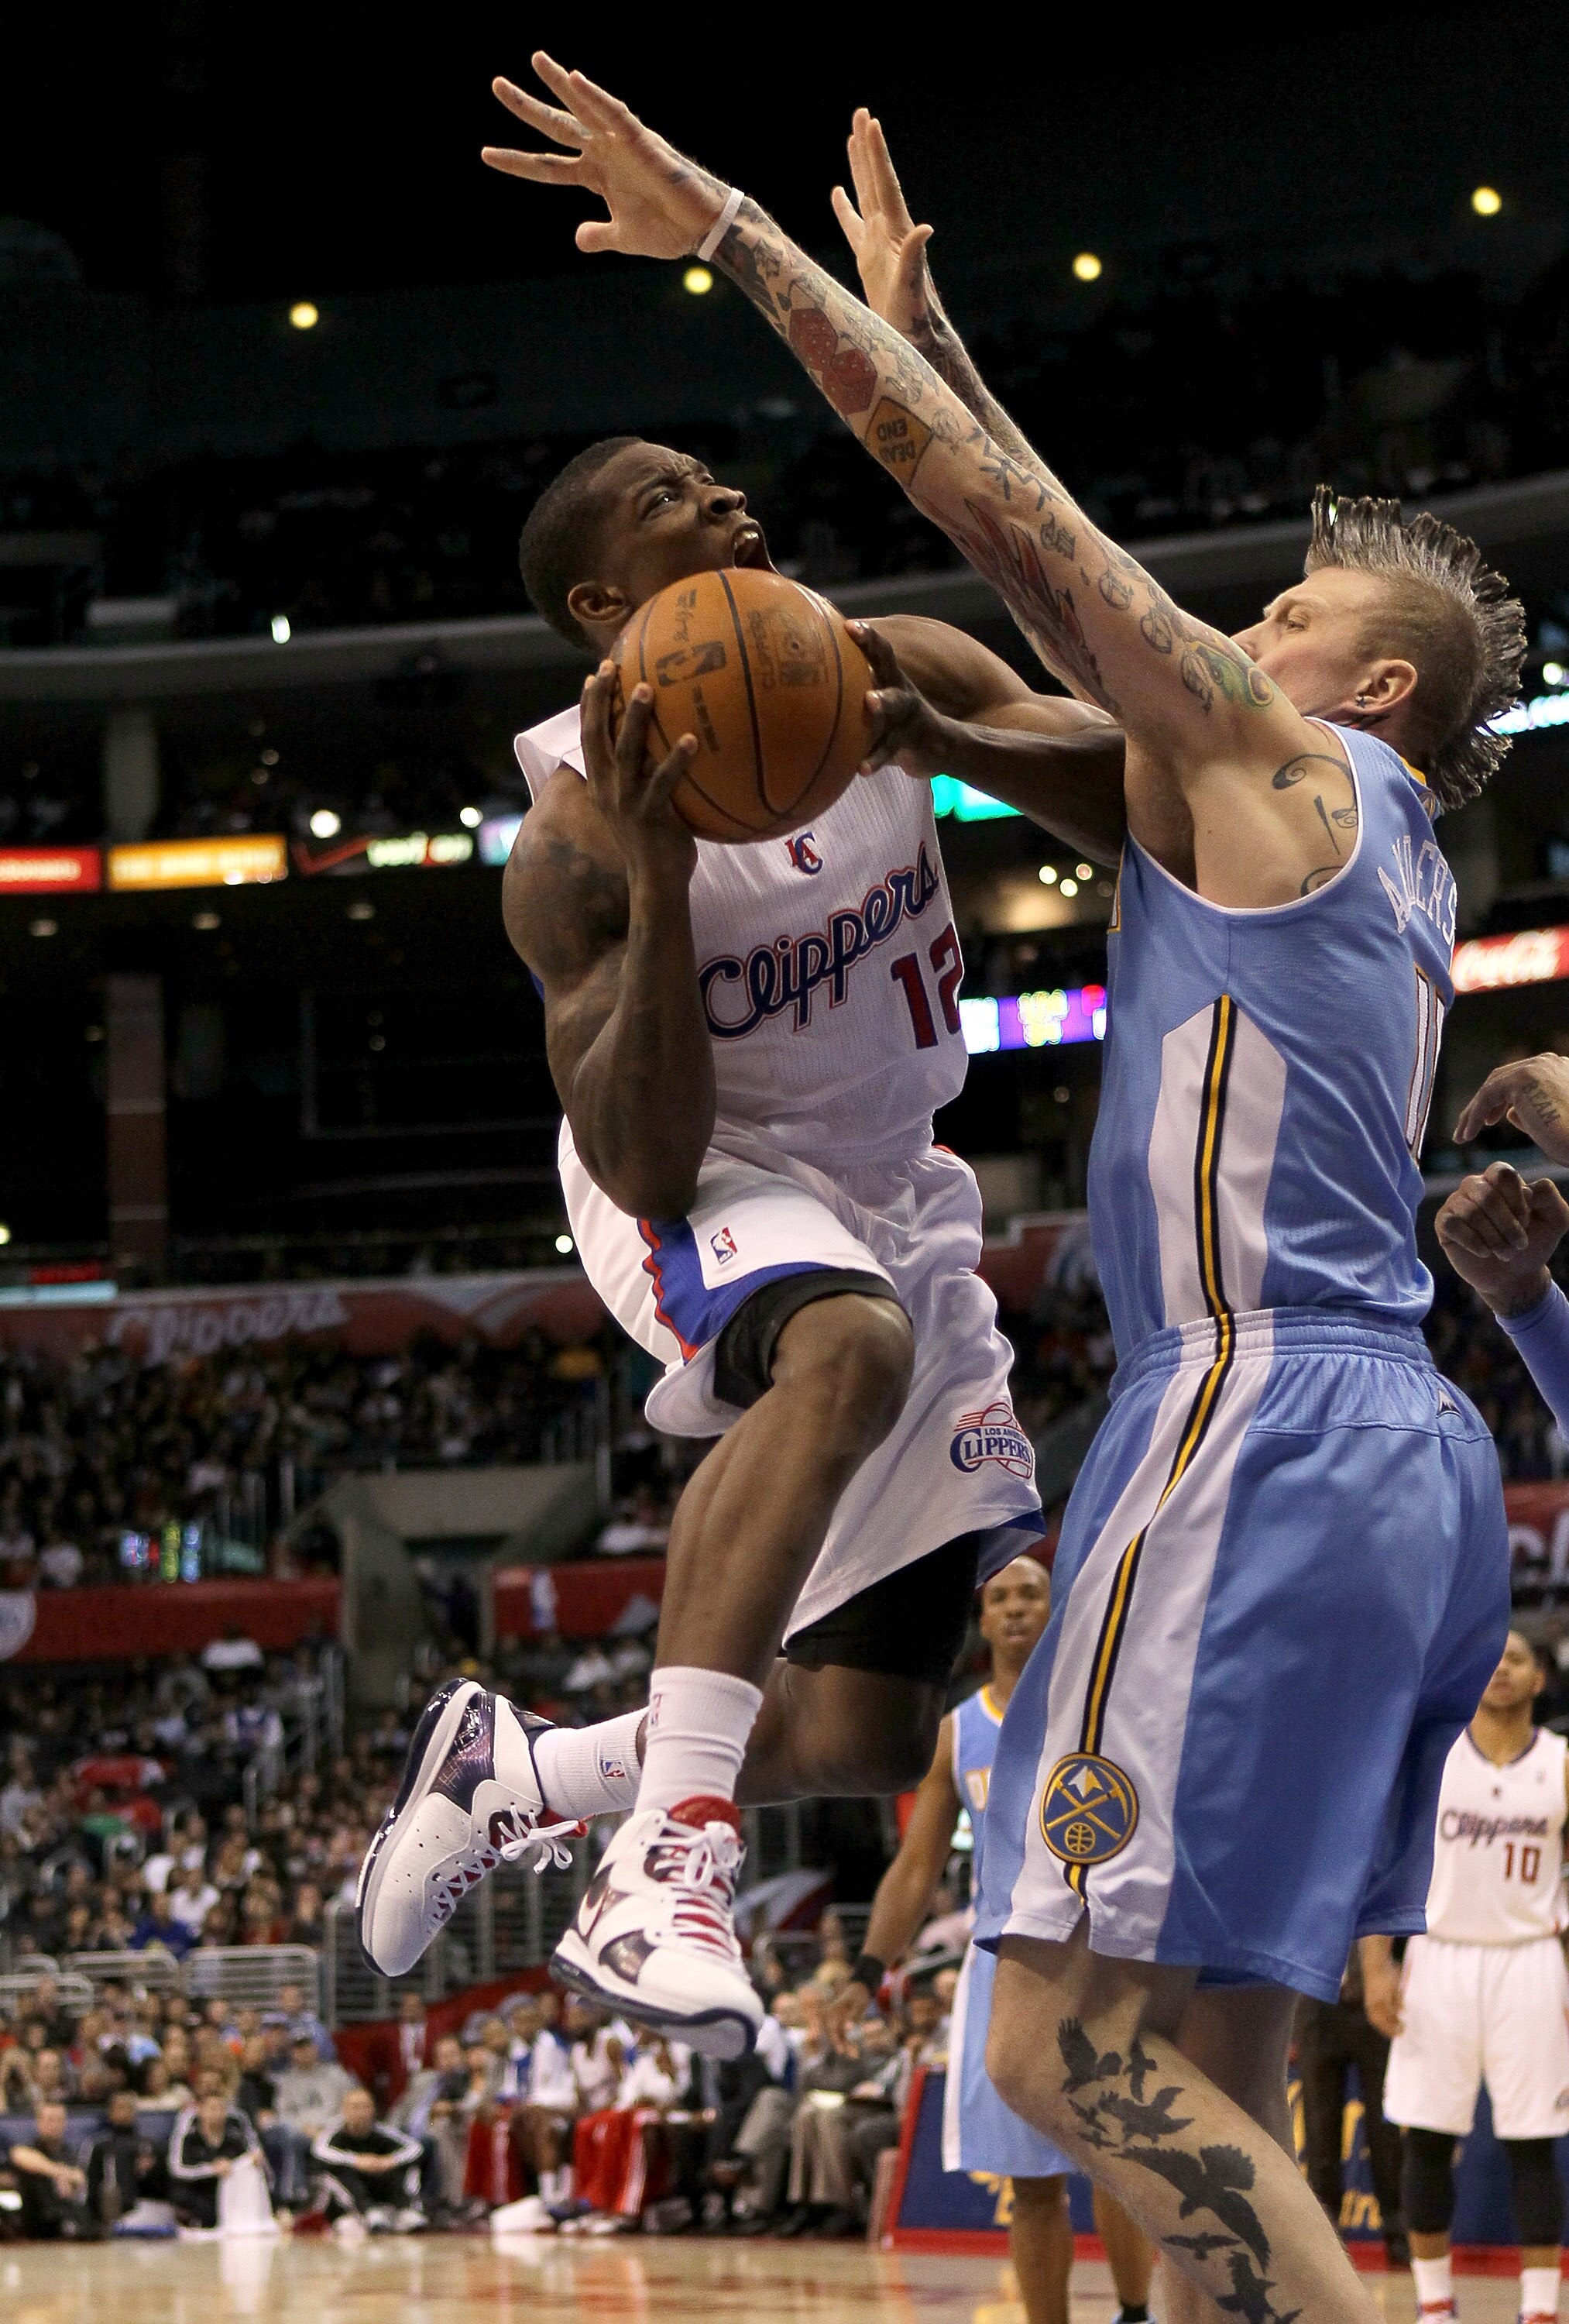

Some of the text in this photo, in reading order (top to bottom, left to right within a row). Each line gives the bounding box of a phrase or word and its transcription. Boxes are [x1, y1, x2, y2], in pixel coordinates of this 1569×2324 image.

[697, 840, 939, 1042] Clippers
[891, 922, 962, 1050] 12
[1505, 1841, 1541, 1884] 10
